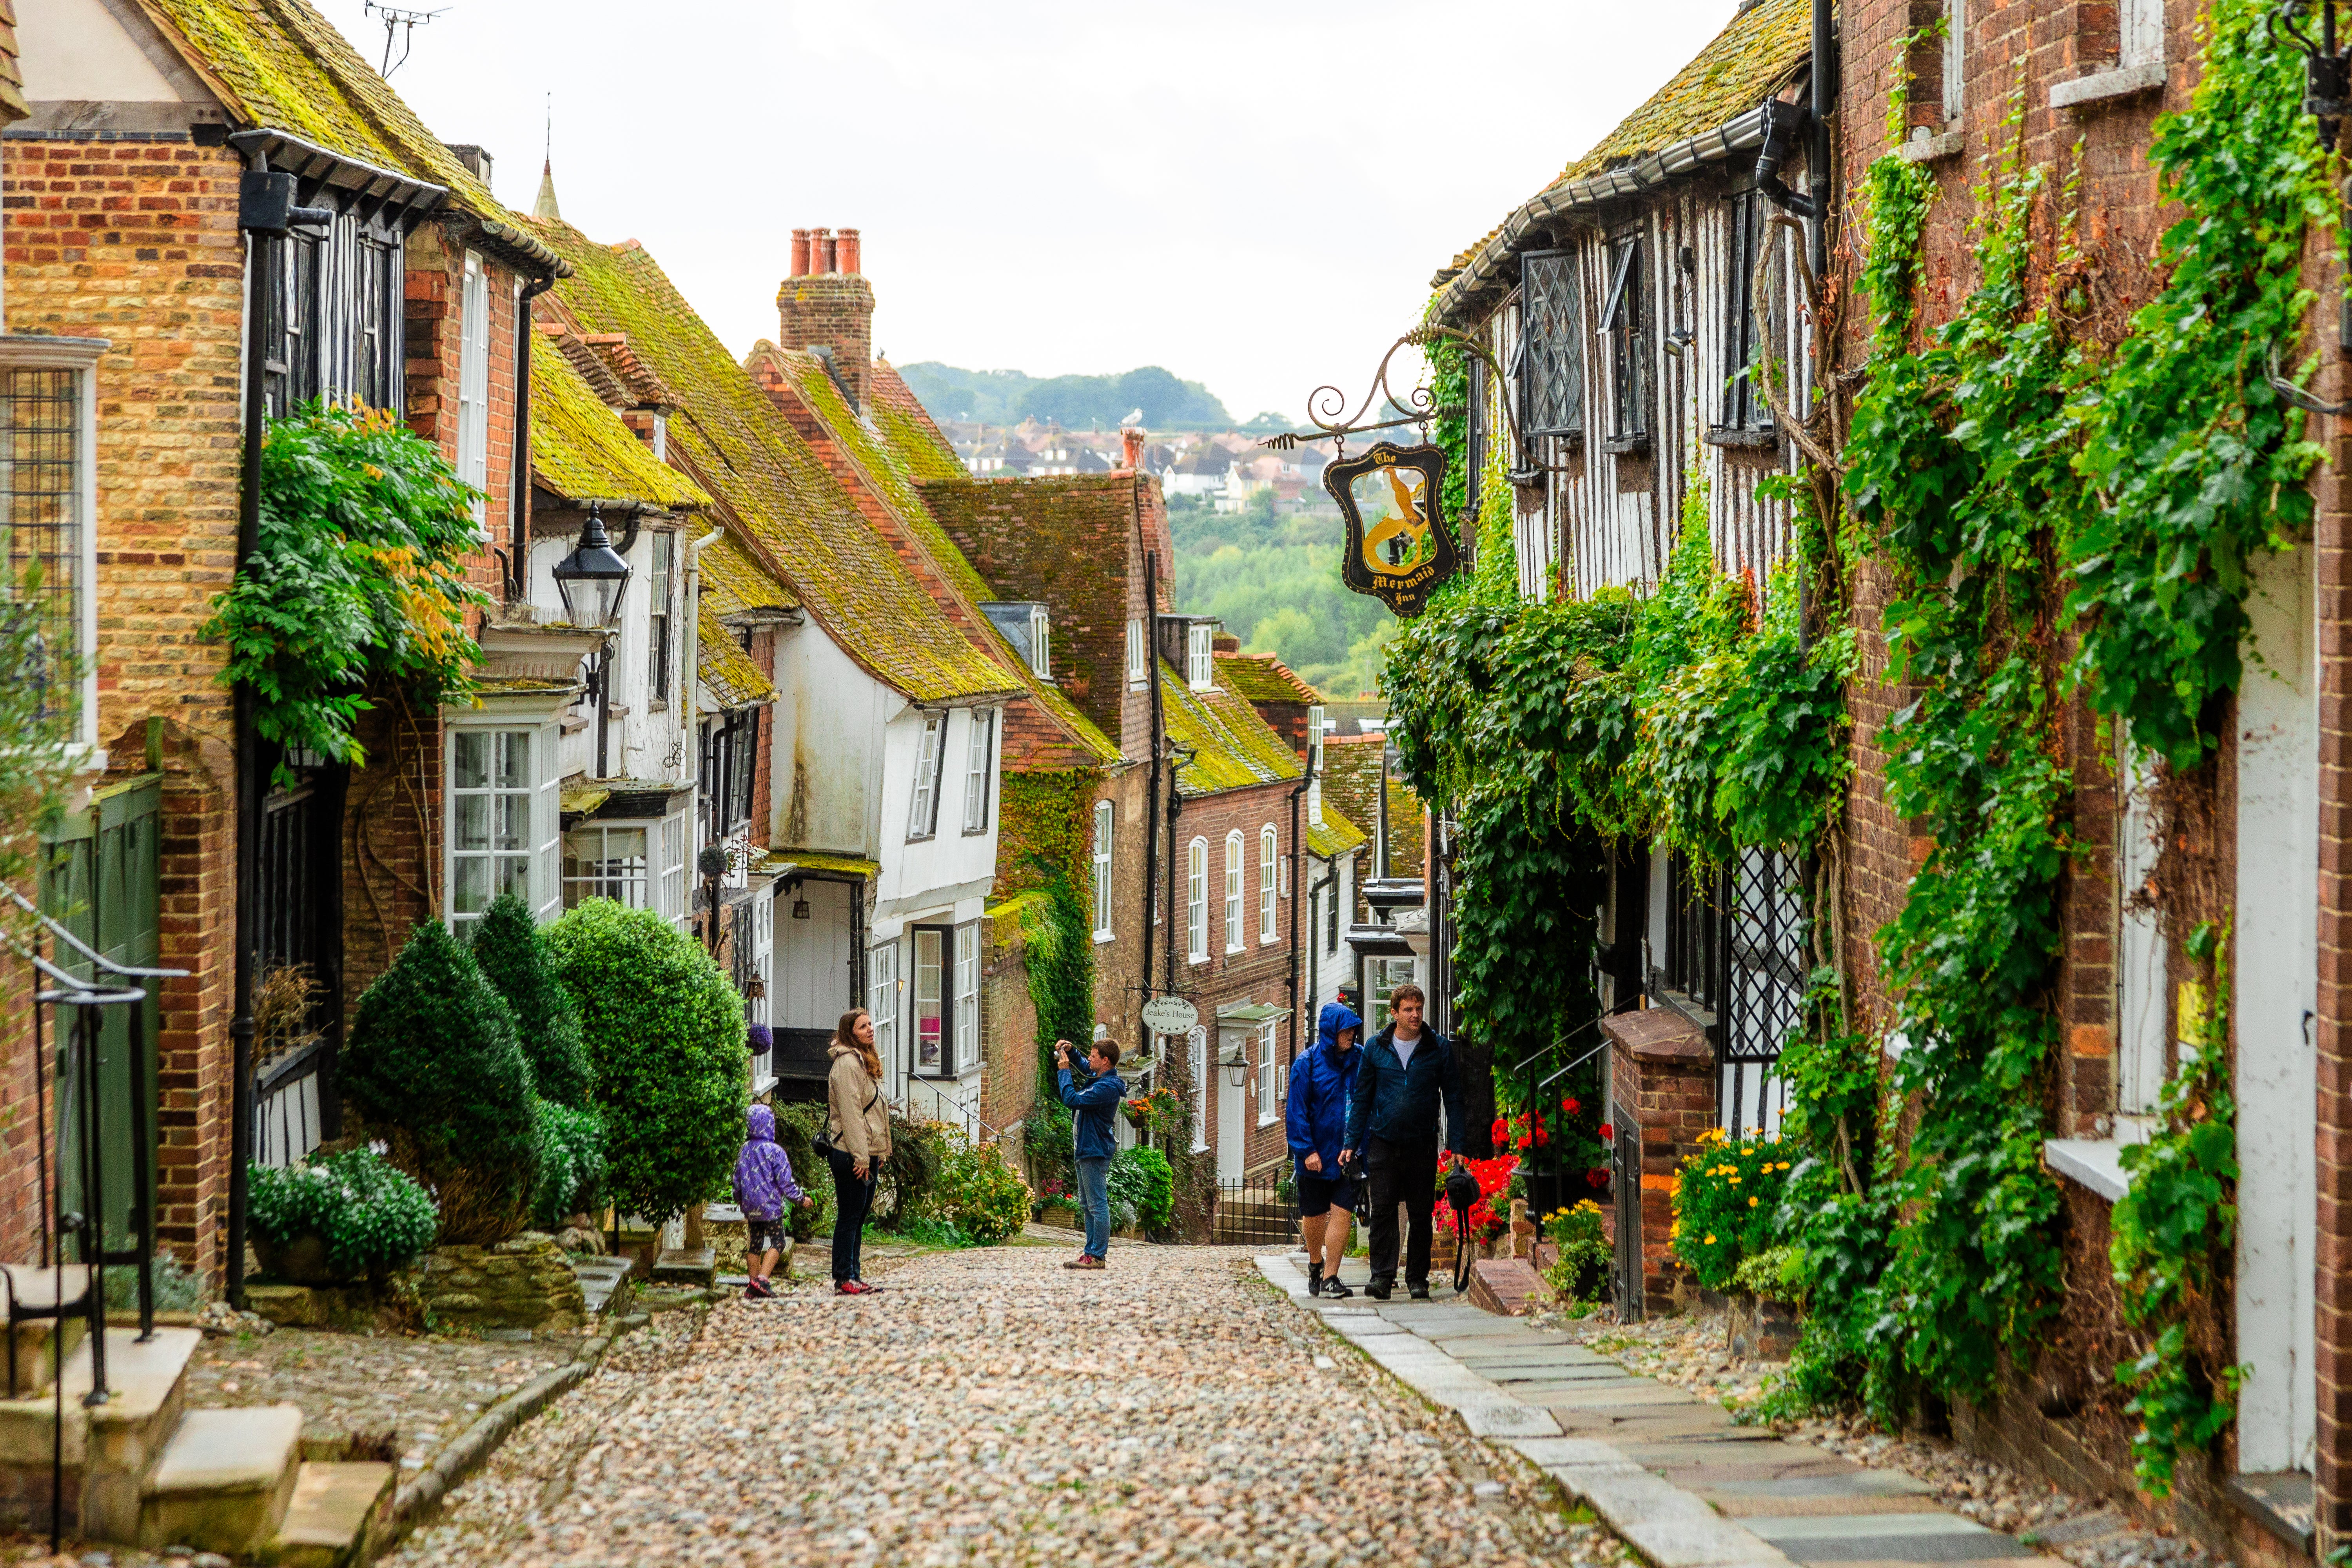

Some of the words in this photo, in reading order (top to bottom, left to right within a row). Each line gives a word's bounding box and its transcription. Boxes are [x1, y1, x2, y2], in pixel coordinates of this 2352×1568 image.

[1374, 452, 1396, 465] The
[1372, 566, 1435, 589] Mermaid
[1396, 592, 1416, 605] Inn
[1146, 1009, 1170, 1017] Jeake's
